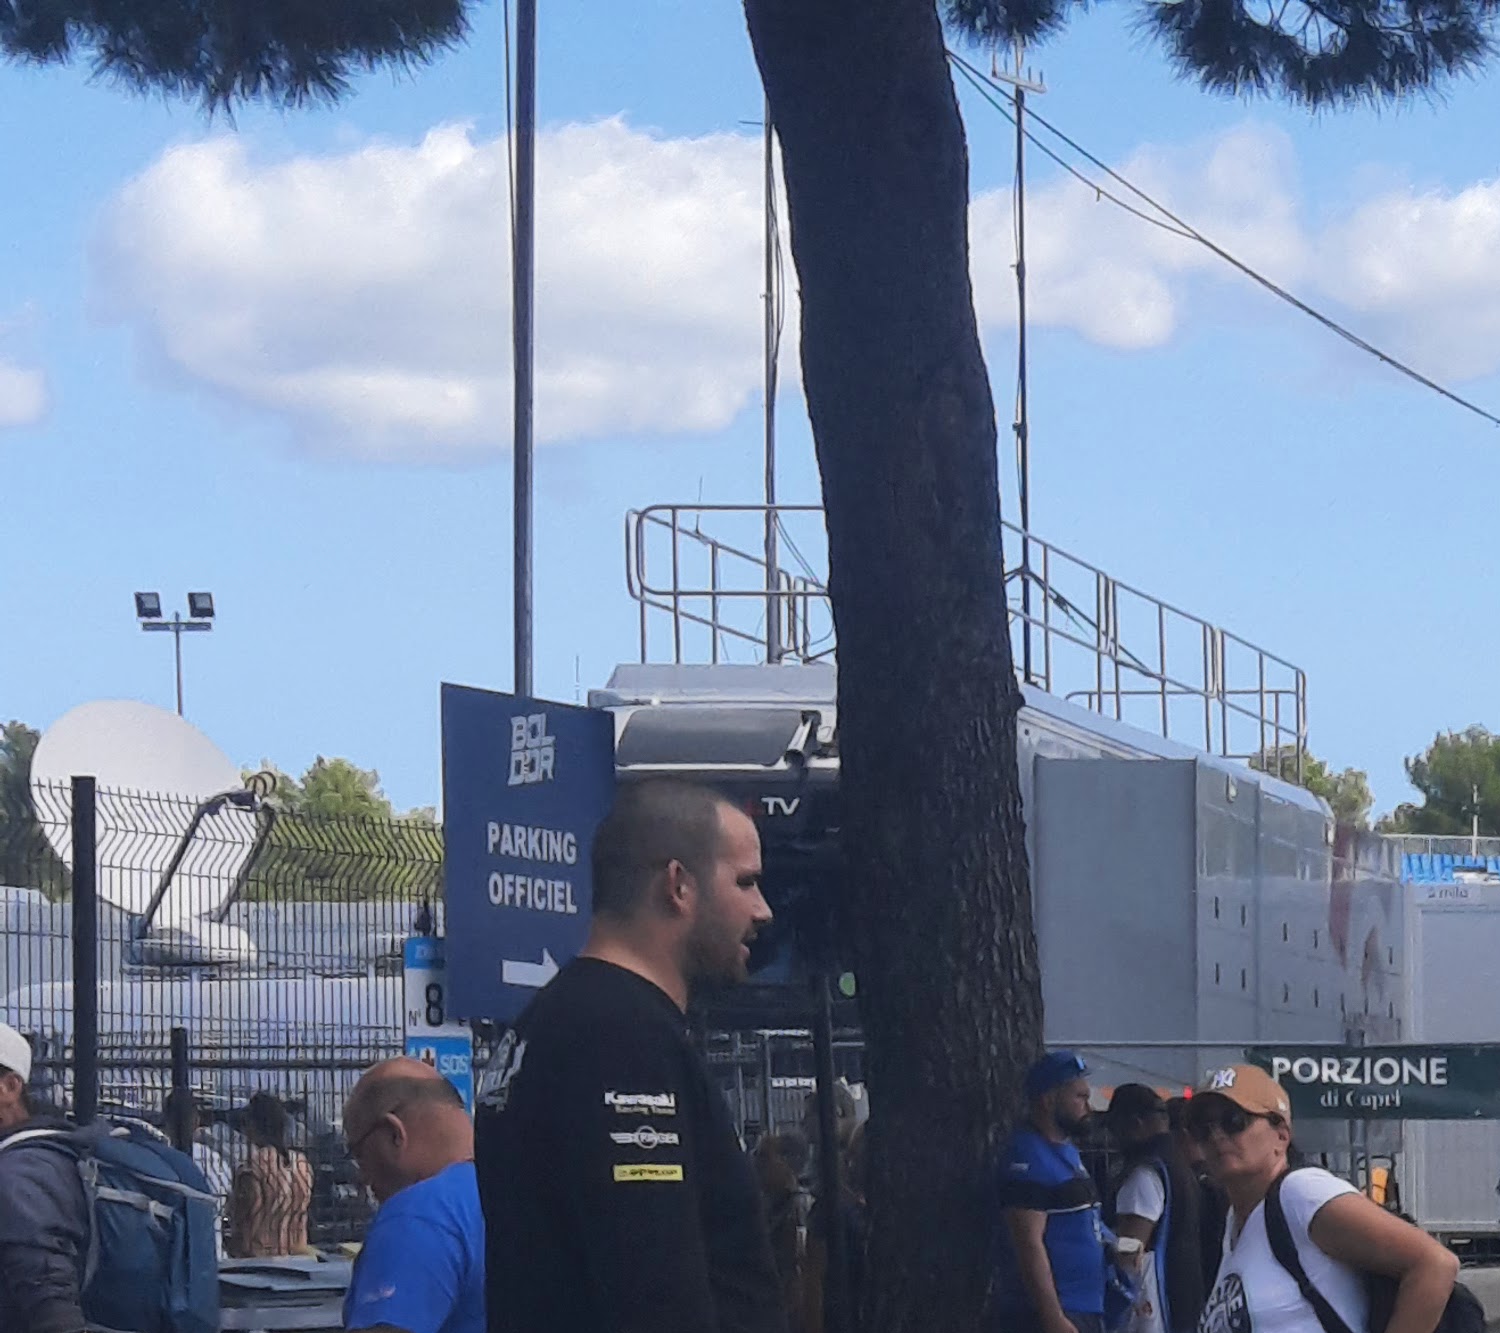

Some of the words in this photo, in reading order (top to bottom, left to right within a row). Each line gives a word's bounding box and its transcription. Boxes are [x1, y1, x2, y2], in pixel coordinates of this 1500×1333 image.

[510, 713, 556, 750] BOL
[760, 796, 800, 816] TV
[487, 821, 577, 865] PARKING
[488, 871, 577, 914] OFFICIEL
[425, 983, 444, 1028] 8
[440, 1055, 469, 1076] SOS
[1271, 1056, 1448, 1085] PORZIONE
